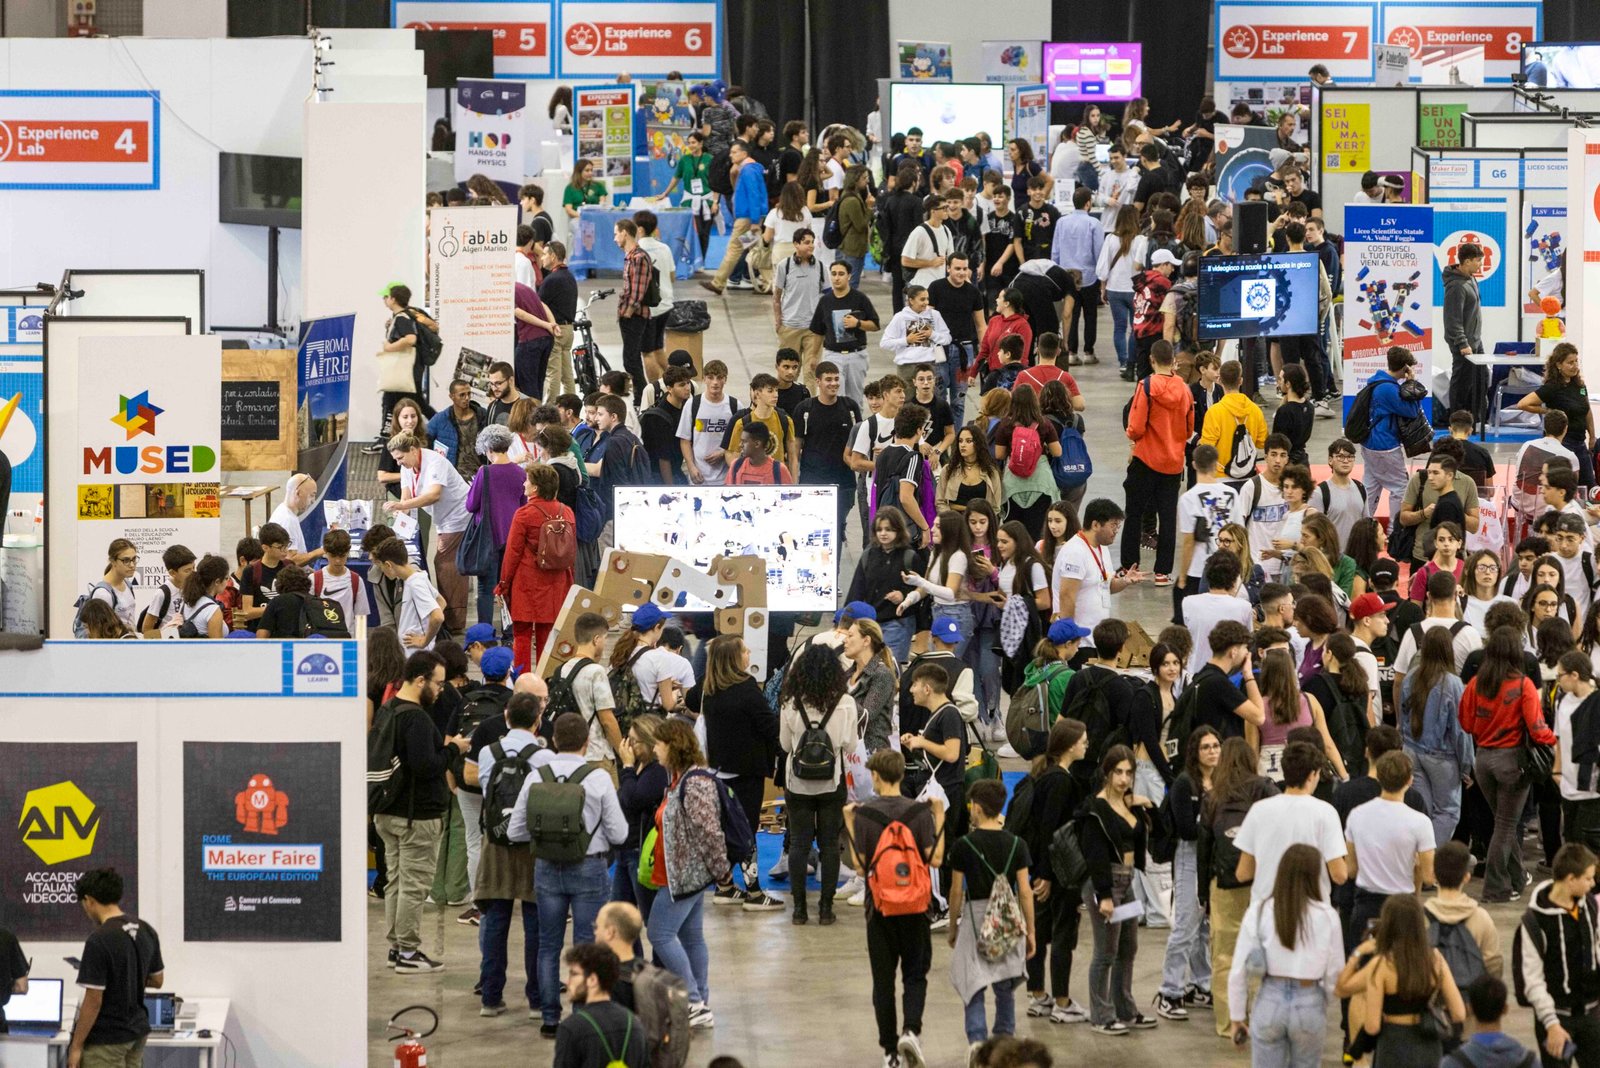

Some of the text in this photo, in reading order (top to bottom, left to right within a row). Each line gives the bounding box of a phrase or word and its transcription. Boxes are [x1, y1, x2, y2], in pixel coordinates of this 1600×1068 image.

[604, 26, 673, 40] Experience
[1262, 30, 1329, 43] Experience
[1427, 30, 1493, 44] Experience
[519, 28, 536, 50] 5
[684, 28, 702, 51] 6
[1342, 32, 1358, 53] 7
[1505, 32, 1521, 54] 8
[604, 39, 628, 51] Lab
[1262, 43, 1285, 54] Lab
[1325, 108, 1346, 118] SEI
[1422, 106, 1444, 117] SEI
[1331, 121, 1349, 130] UN
[1434, 118, 1453, 128] UN
[18, 126, 99, 142] Experience
[114, 128, 137, 155] 4
[469, 132, 511, 149] HOP
[1335, 141, 1366, 150] KER?
[18, 142, 45, 155] Lab
[477, 158, 507, 167] PHYSICS
[1492, 169, 1507, 178] G6
[1380, 218, 1397, 226] LSV
[462, 230, 508, 245] fablab
[1395, 235, 1415, 243] Foggia
[462, 245, 483, 254] Algeri
[324, 337, 350, 354] ROMA
[324, 355, 350, 376] TRE
[83, 445, 216, 475] MUSED
[202, 835, 232, 843] ROME
[208, 850, 316, 865] Maker Faire
[24, 872, 85, 883] ACCADEM
[207, 872, 319, 880] THE EUROPEAN EDITION
[33, 882, 76, 893] ITALIAN
[238, 896, 301, 904] Camera di Commercio
[238, 904, 256, 912] Roma
